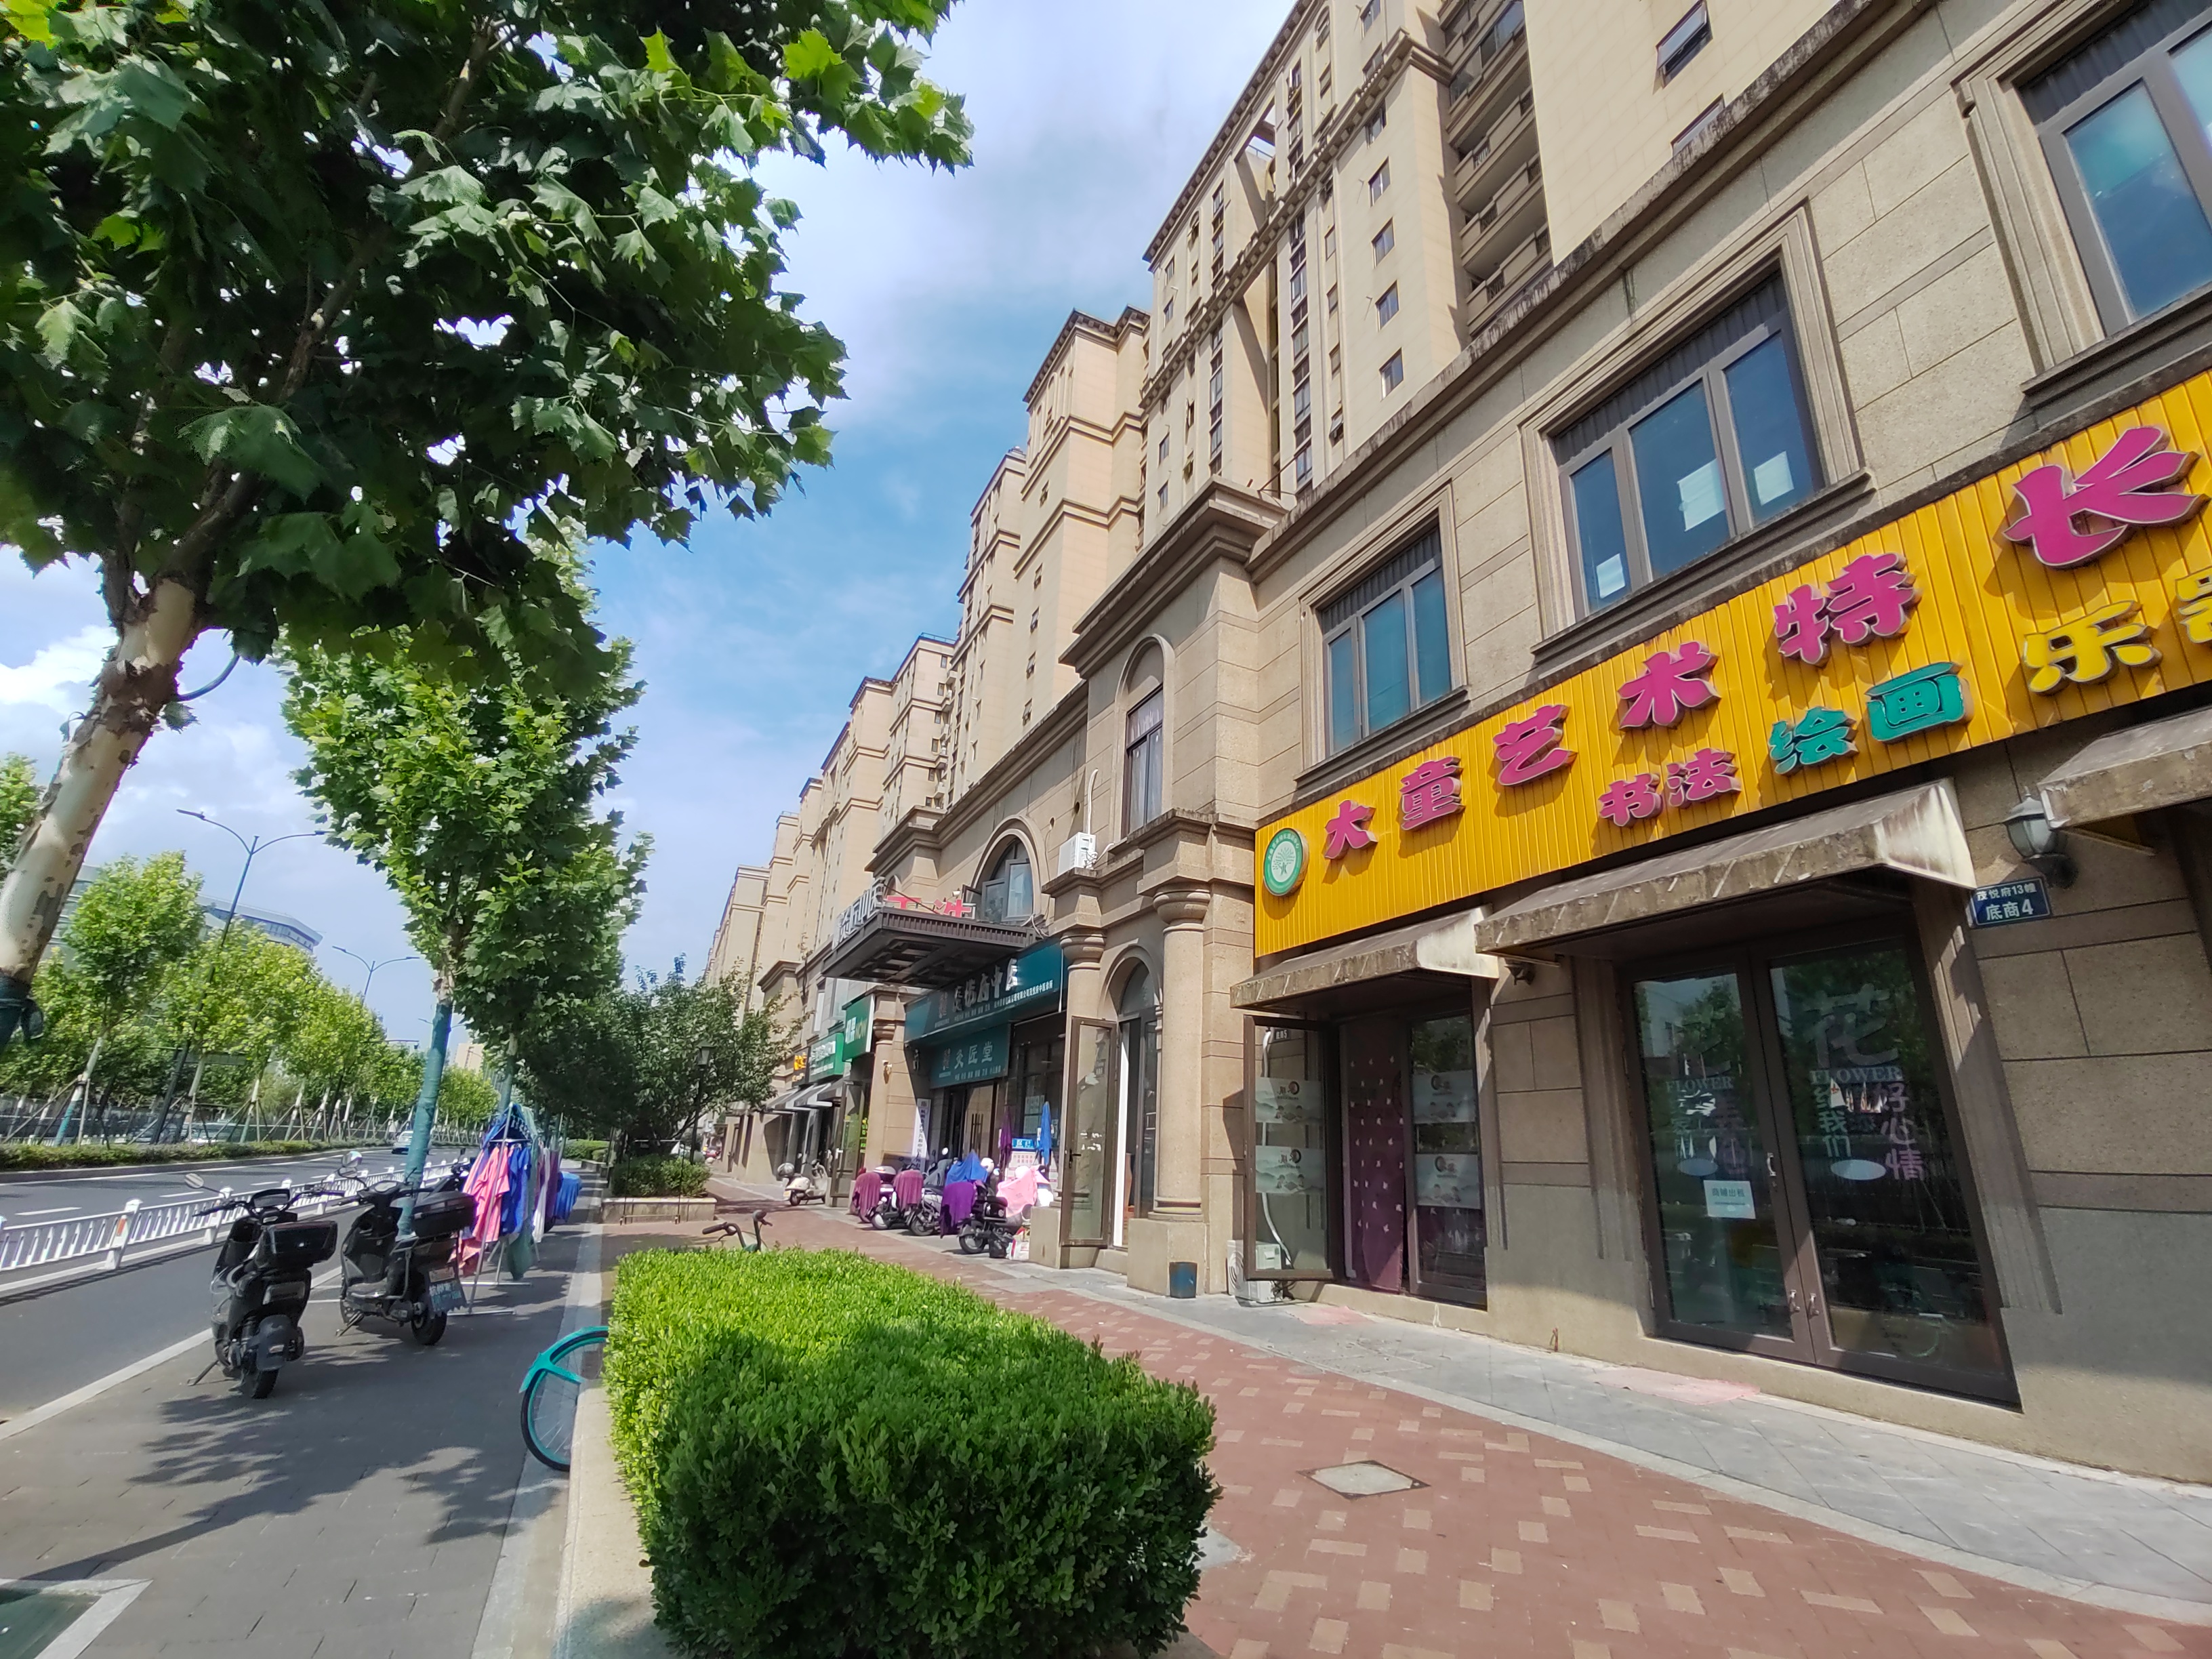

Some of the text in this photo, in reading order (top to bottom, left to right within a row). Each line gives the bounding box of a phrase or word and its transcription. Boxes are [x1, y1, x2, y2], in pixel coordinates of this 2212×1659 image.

[1599, 747, 1741, 827] 书法
[1769, 661, 1969, 775] 绘画
[1976, 882, 2037, 901] 茂悦府13幢
[1986, 899, 2034, 921] 底商4
[1803, 983, 1898, 1068] 花
[954, 1040, 994, 1070] 灸匠堂
[1666, 1076, 1734, 1092] FLOWER
[1809, 1067, 1902, 1085] FLOWER
